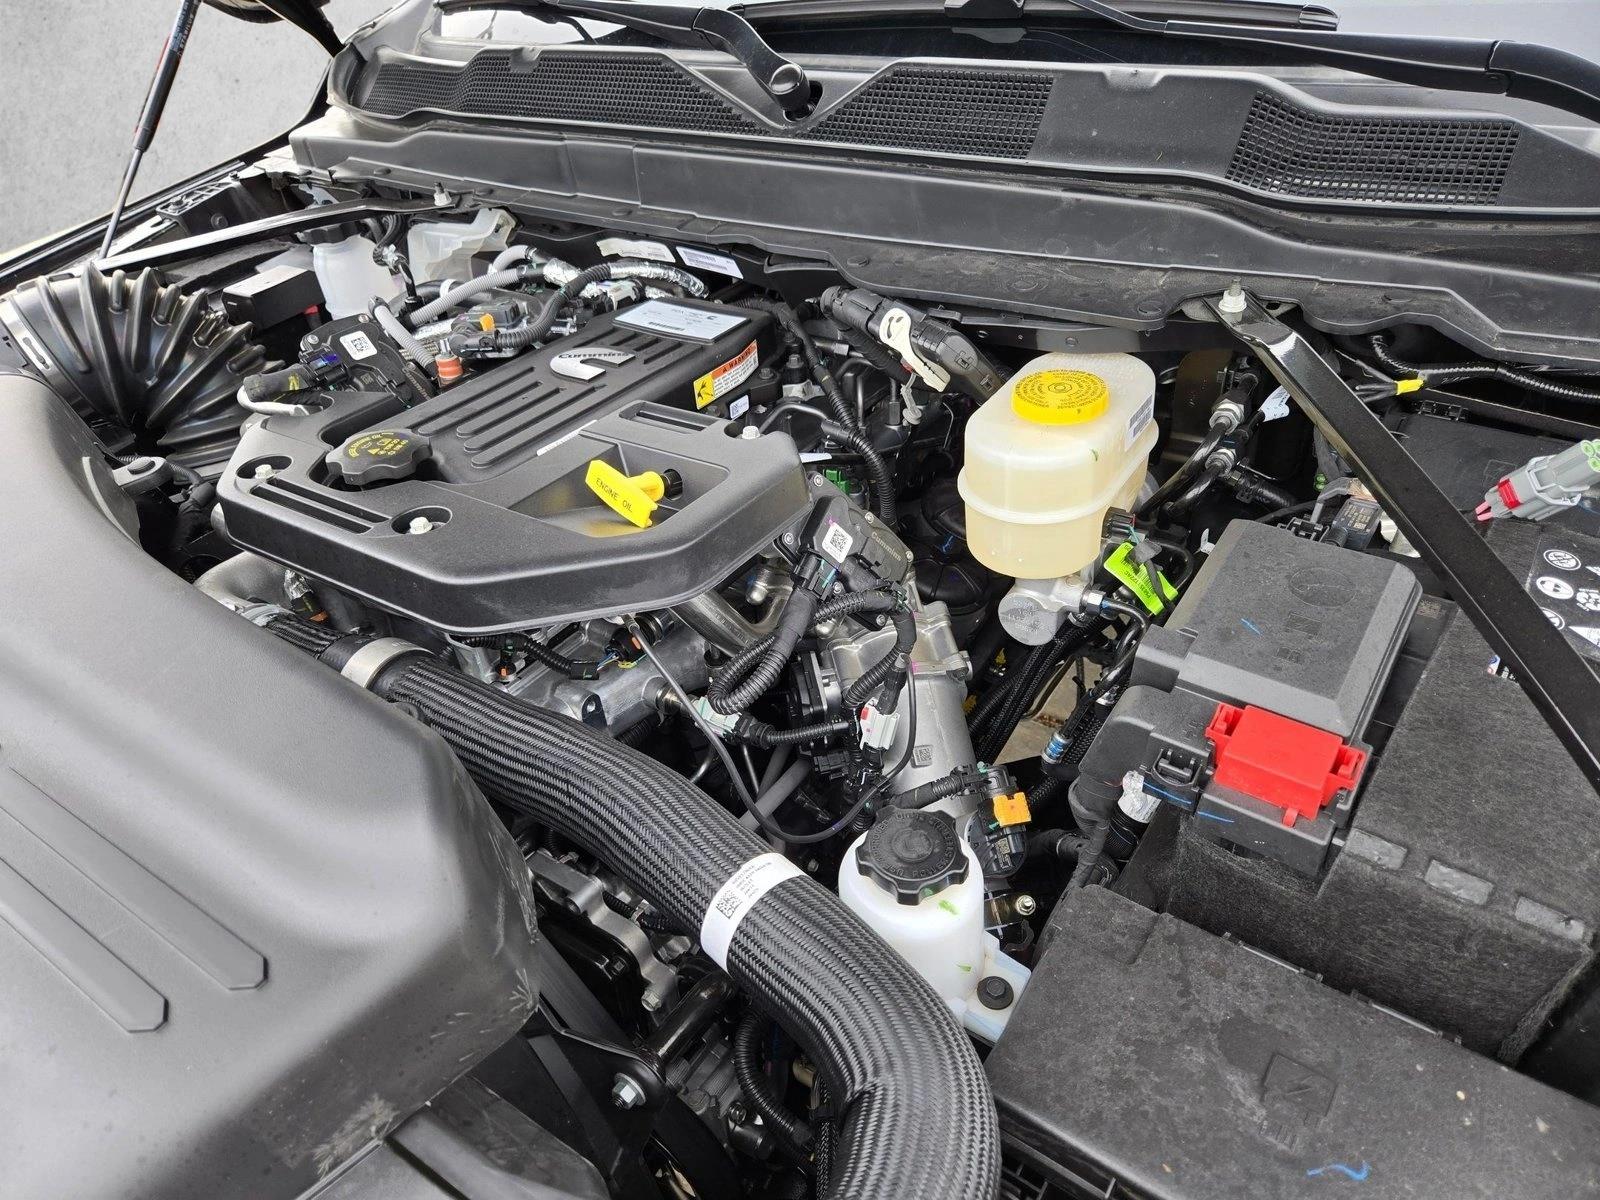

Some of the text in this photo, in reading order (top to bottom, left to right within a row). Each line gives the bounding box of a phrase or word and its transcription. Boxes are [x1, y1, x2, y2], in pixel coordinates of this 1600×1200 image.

[596, 478, 633, 512] ENGINE OIL
[871, 531, 901, 561] Cummins
[871, 819, 904, 877] USE APPROVED
